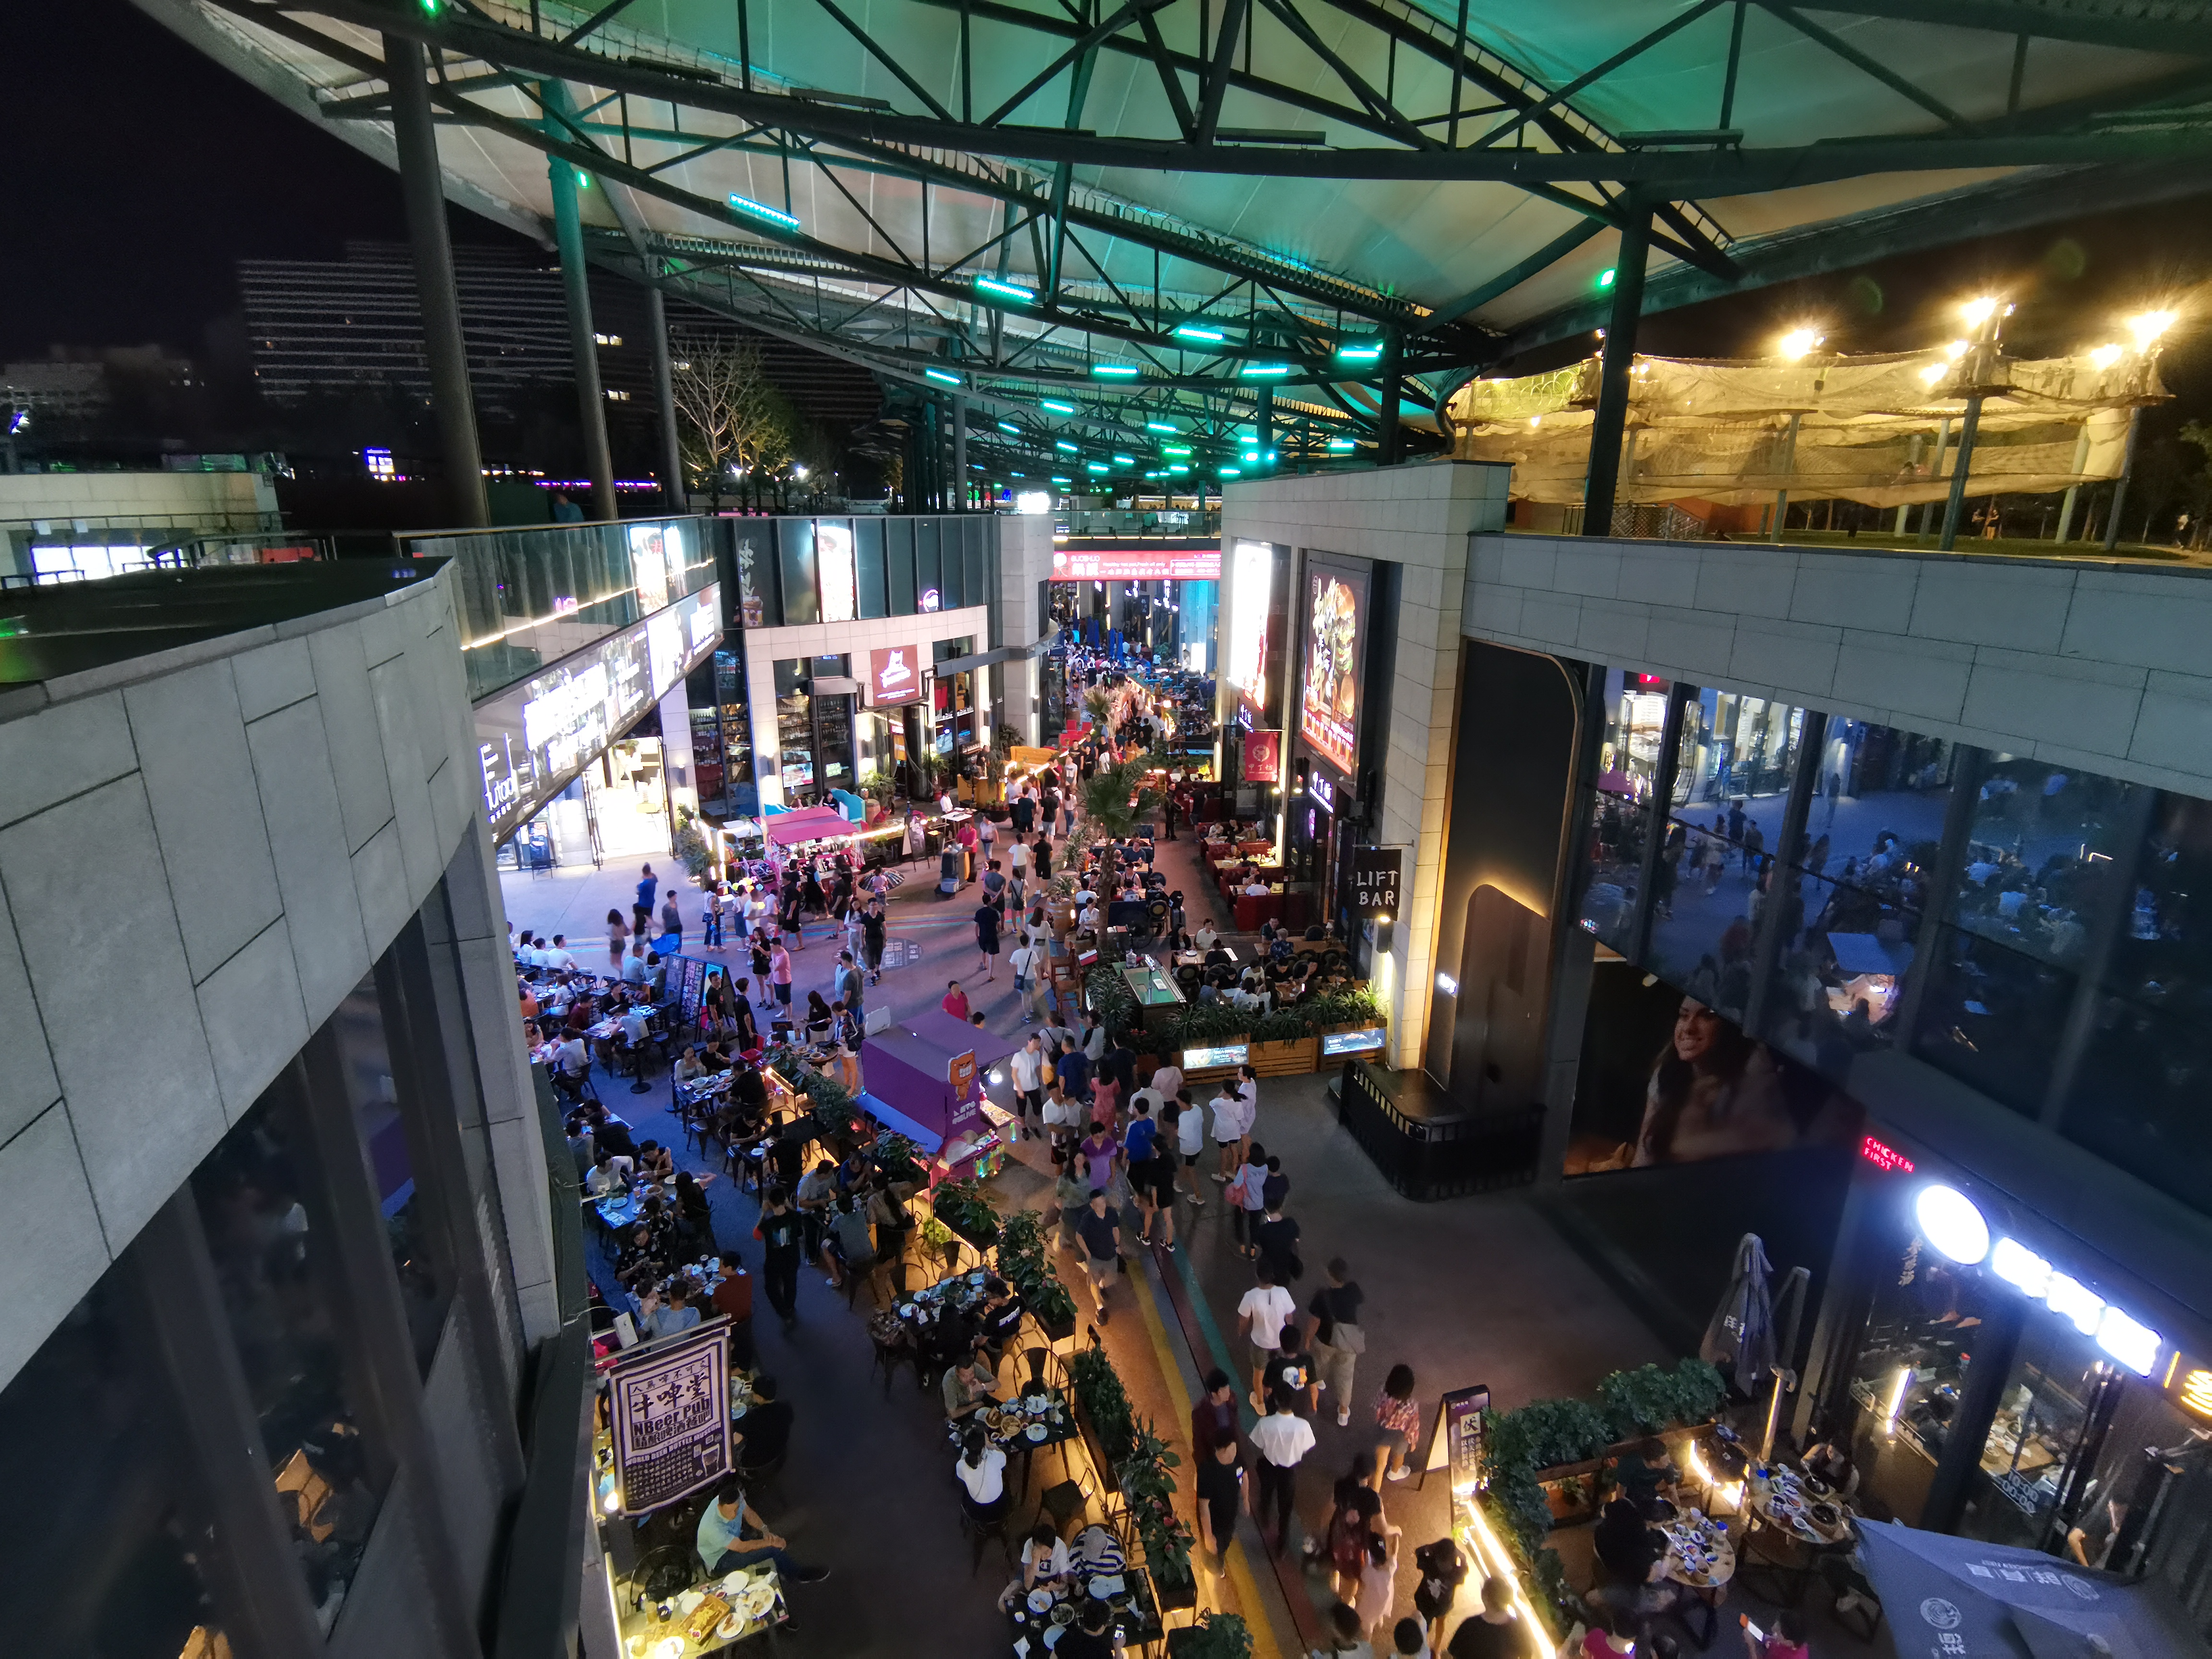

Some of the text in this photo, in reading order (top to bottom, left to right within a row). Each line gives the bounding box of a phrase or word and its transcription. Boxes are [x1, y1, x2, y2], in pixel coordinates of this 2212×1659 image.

[1357, 870, 1399, 886] LIFT
[1359, 890, 1394, 906] BAR
[1864, 1147, 1892, 1170] FIRST
[1866, 1137, 1913, 1172] CHICKEN
[632, 1372, 709, 1419] 牛啤堂
[634, 1397, 710, 1436] NBeer Pub
